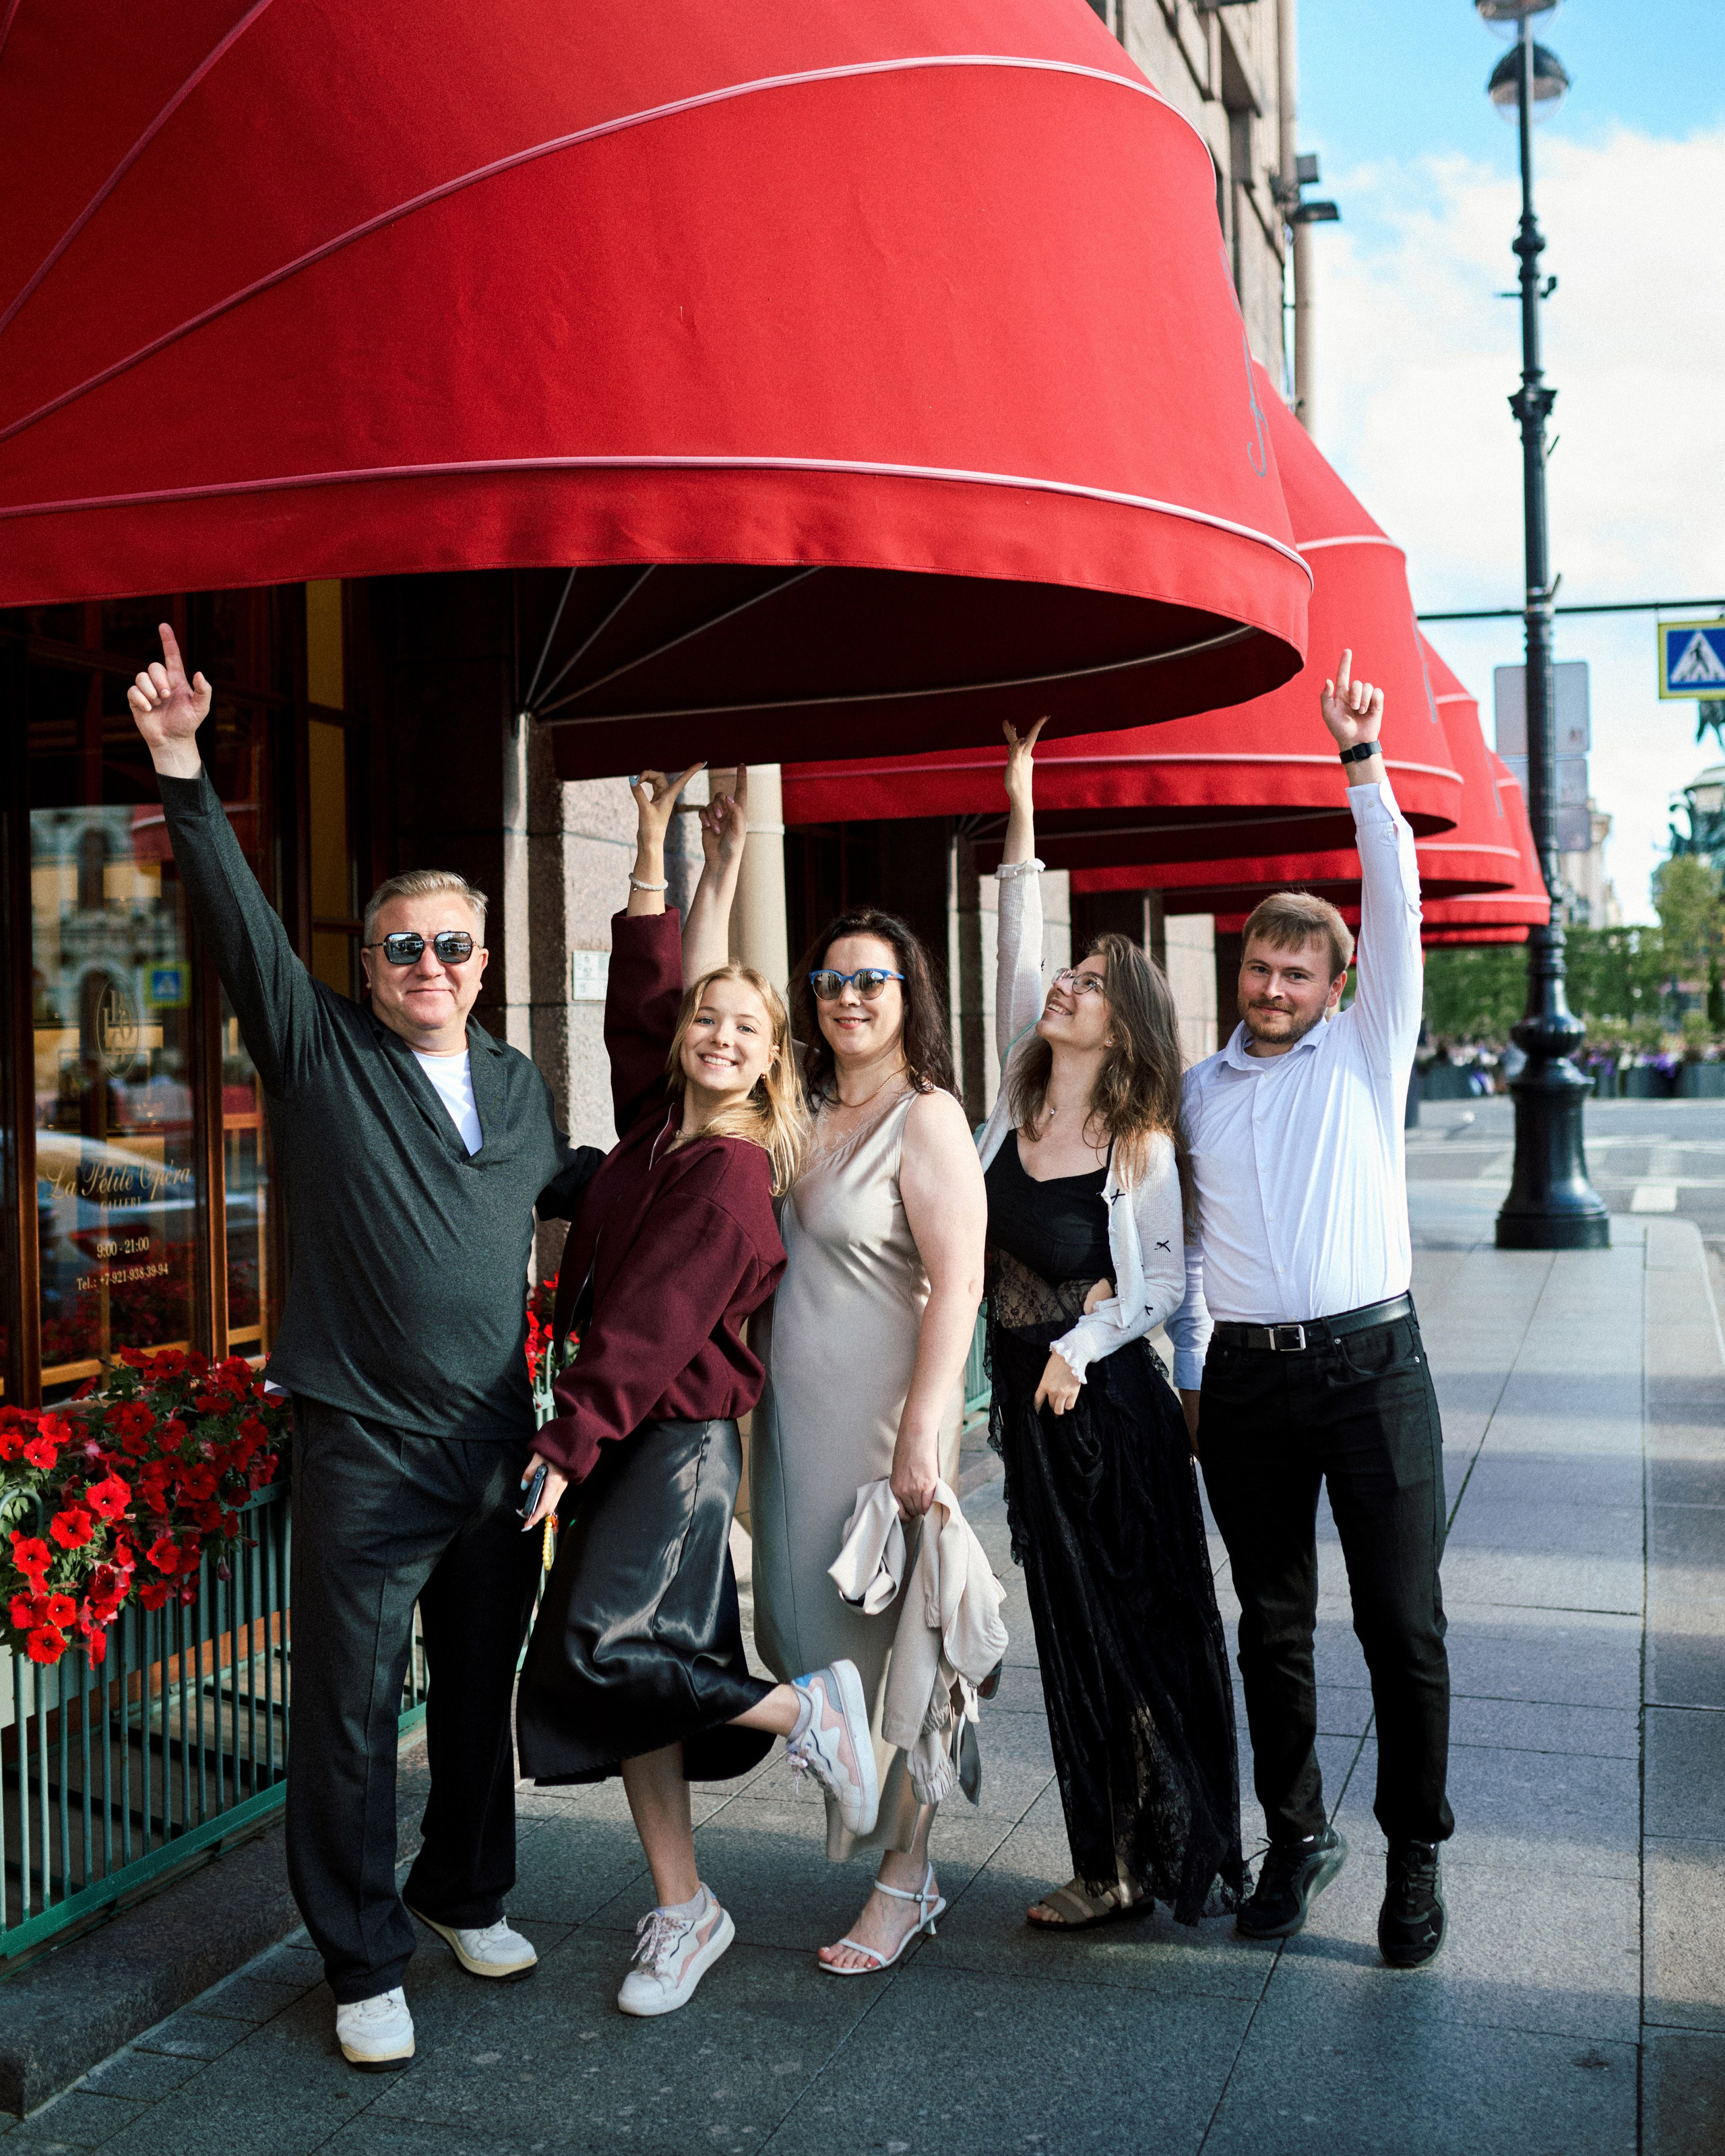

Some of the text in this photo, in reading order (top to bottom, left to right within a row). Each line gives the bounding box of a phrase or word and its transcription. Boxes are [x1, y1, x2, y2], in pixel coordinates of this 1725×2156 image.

[46, 1164, 77, 1199] La
[82, 1158, 133, 1197] Petite
[96, 1241, 117, 1259] 9:00
[124, 1236, 150, 1254] 21:00
